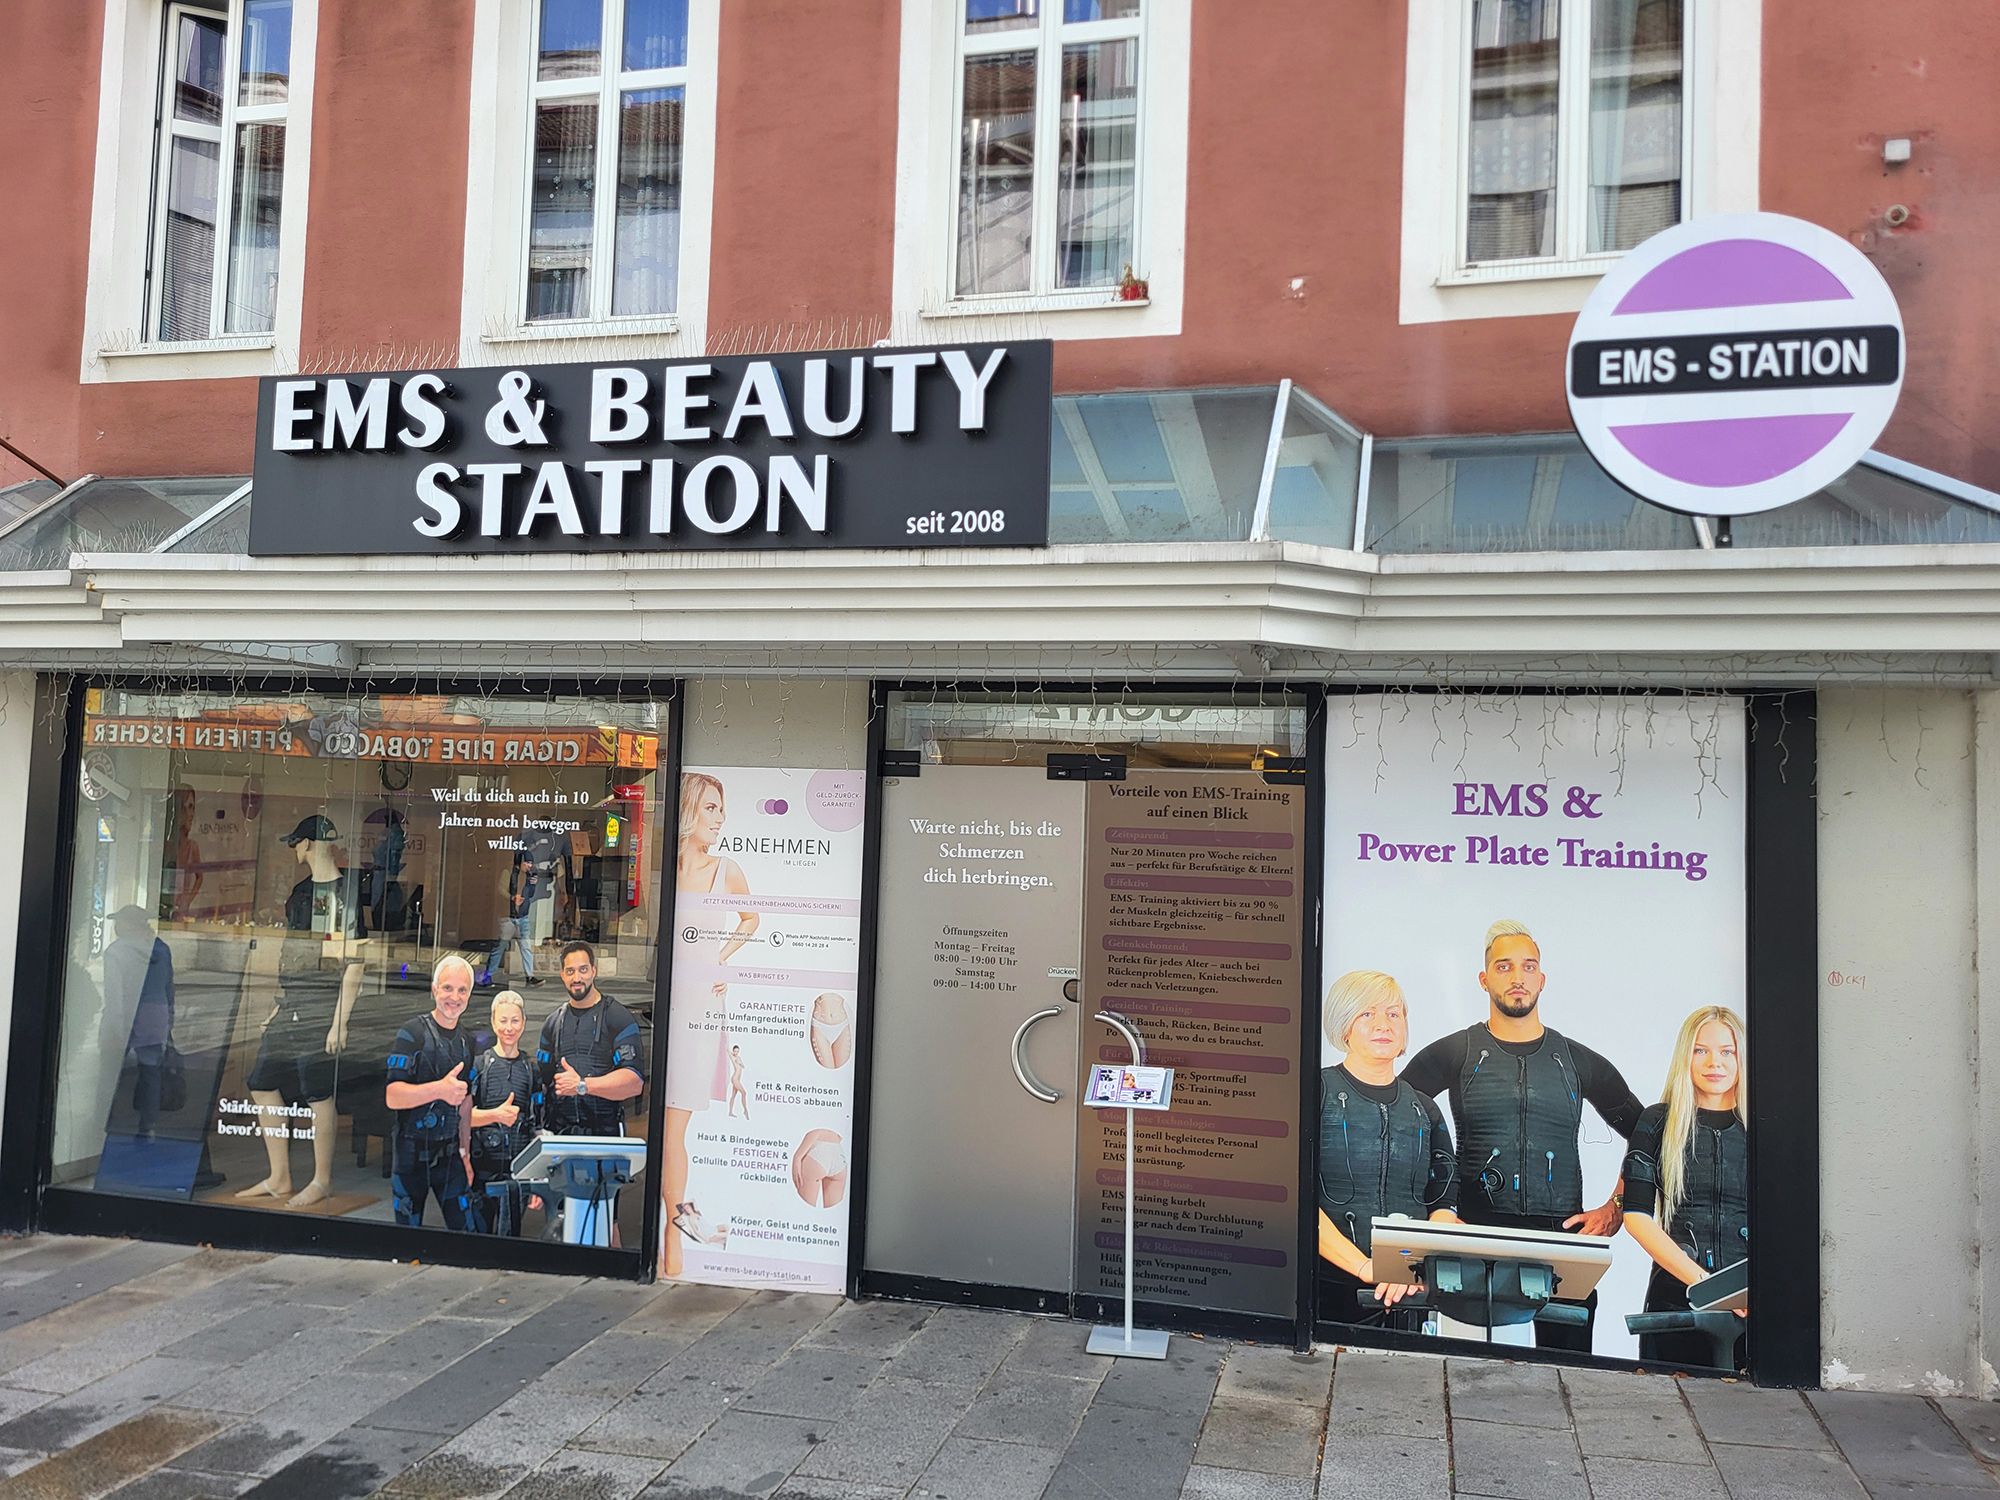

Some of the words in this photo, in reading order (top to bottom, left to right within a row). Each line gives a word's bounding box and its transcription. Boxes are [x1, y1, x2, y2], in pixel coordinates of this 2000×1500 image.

[1599, 348, 1676, 385] EMS
[1687, 362, 1700, 372] -
[1708, 338, 1868, 380] STATION
[273, 374, 447, 450] EMS
[485, 371, 549, 446] &
[590, 348, 1007, 442] BEAUTY
[412, 454, 829, 537] STATION
[906, 512, 944, 534] seit
[950, 510, 1005, 533] 2008
[431, 788, 460, 802] Weil
[464, 789, 482, 802] du
[486, 788, 514, 802] dich
[518, 789, 549, 803] auch
[554, 791, 567, 804] in
[573, 791, 589, 805] 10
[1108, 784, 1160, 798] Vorteile
[1164, 788, 1188, 798] von
[1192, 787, 1290, 805] EMS-Training
[1451, 783, 1549, 817] EMS
[1562, 785, 1603, 819] &
[1147, 805, 1170, 817] auf
[1172, 807, 1208, 818] einen
[1213, 807, 1248, 820] Blick
[438, 812, 482, 829] Jahren
[486, 814, 519, 828] noch
[523, 815, 580, 834] bewegen
[910, 818, 956, 834] Warte
[960, 820, 1004, 837] nicht,
[1009, 821, 1032, 836] bis
[1037, 821, 1062, 837] die
[488, 836, 528, 850] willst.
[718, 836, 831, 855] ABNEHMEN
[939, 842, 1024, 859] Schmerzen
[1110, 847, 1129, 856] Nur
[1132, 848, 1143, 857] 20
[1146, 849, 1186, 858] Minuten
[1189, 851, 1205, 861] pro
[1207, 851, 1240, 860] Woche
[1242, 852, 1277, 862] reichen
[1357, 833, 1456, 863] Power
[1465, 836, 1549, 866] Plate
[1556, 838, 1708, 882] Training
[1136, 860, 1170, 870] perfekt
[1172, 862, 1186, 870] für
[1189, 863, 1246, 875] Berufstätige
[1248, 865, 1258, 873] &
[1260, 865, 1294, 875] Eltern!
[923, 867, 957, 883] dich
[961, 868, 1053, 891] herbringen.
[1139, 895, 1178, 906] Training
[1180, 897, 1221, 907] aktiviert
[1223, 899, 1237, 908] bis
[1253, 901, 1266, 909] 90
[1268, 901, 1279, 910] %
[1110, 906, 1125, 914] der
[1127, 907, 1167, 917] Muskeln
[1170, 909, 1223, 921] gleichzeitig
[1234, 912, 1249, 920] für
[1251, 913, 1285, 922] schnell
[942, 925, 1008, 938] Öffnungszeiten
[1109, 918, 1151, 928] sichtbare
[1154, 920, 1206, 932] Ergebnisse.
[934, 941, 970, 953] Montag
[981, 943, 1015, 955] Freitag
[934, 954, 959, 963] 08:00
[970, 955, 996, 965] 19:00
[999, 956, 1018, 966] Uhr
[1108, 955, 1140, 964] Perfekt
[1143, 956, 1157, 965] für
[1159, 957, 1183, 967] jedes
[1185, 959, 1209, 968] Alter
[1220, 961, 1242, 970] auch
[1245, 962, 1260, 971] bei
[955, 967, 995, 979] Samstag
[1048, 967, 1076, 975] Drücken
[1108, 967, 1195, 981] Rückenproblemen,
[1199, 971, 1283, 985] Kniebeschwerden
[933, 979, 959, 988] 09:00
[970, 981, 995, 990] 14:00
[999, 982, 1016, 992] Uhr
[1107, 980, 1128, 989] oder
[1131, 982, 1152, 990] nach
[1155, 983, 1218, 994] Verletzungen.
[739, 1001, 805, 1013] GARANTIERTE
[729, 1012, 805, 1025] Umfangreduktion
[1137, 1018, 1169, 1028] Bauch,
[1172, 1020, 1210, 1031] Rücken,
[1213, 1023, 1240, 1032] Beine
[1242, 1026, 1262, 1034] und
[689, 1022, 702, 1030] bei
[751, 1026, 805, 1038] Behandlung
[1219, 1036, 1264, 1047] brauchst.
[756, 1082, 773, 1090] Fett
[785, 1084, 839, 1095] Reiterhosen
[755, 1092, 801, 1104] MÜHELOS
[804, 1097, 842, 1108] abbauen
[219, 1098, 264, 1115] Stärker
[266, 1102, 316, 1119] werden,
[217, 1119, 261, 1136] bevor's
[264, 1123, 289, 1138] weh
[293, 1126, 316, 1139] tut!
[698, 1132, 718, 1141] Haut
[729, 1136, 789, 1147] Bindegewebe
[1165, 1133, 1215, 1146] begleitetes
[1217, 1138, 1258, 1149] Personal
[733, 1147, 779, 1158] FESTIGEN
[692, 1156, 728, 1166] Cellulite
[731, 1160, 787, 1171] DAUERHAFT
[741, 1173, 787, 1184] rückbilden
[731, 1216, 763, 1227] Körper,
[766, 1219, 790, 1229] Geist
[792, 1223, 809, 1231] und
[812, 1224, 837, 1234] Seele
[1194, 1212, 1264, 1229] Durchblutung
[730, 1228, 784, 1240] ANGENEHM
[786, 1235, 840, 1247] entspannen
[704, 1263, 812, 1282] www.ems-beauty-station.at
